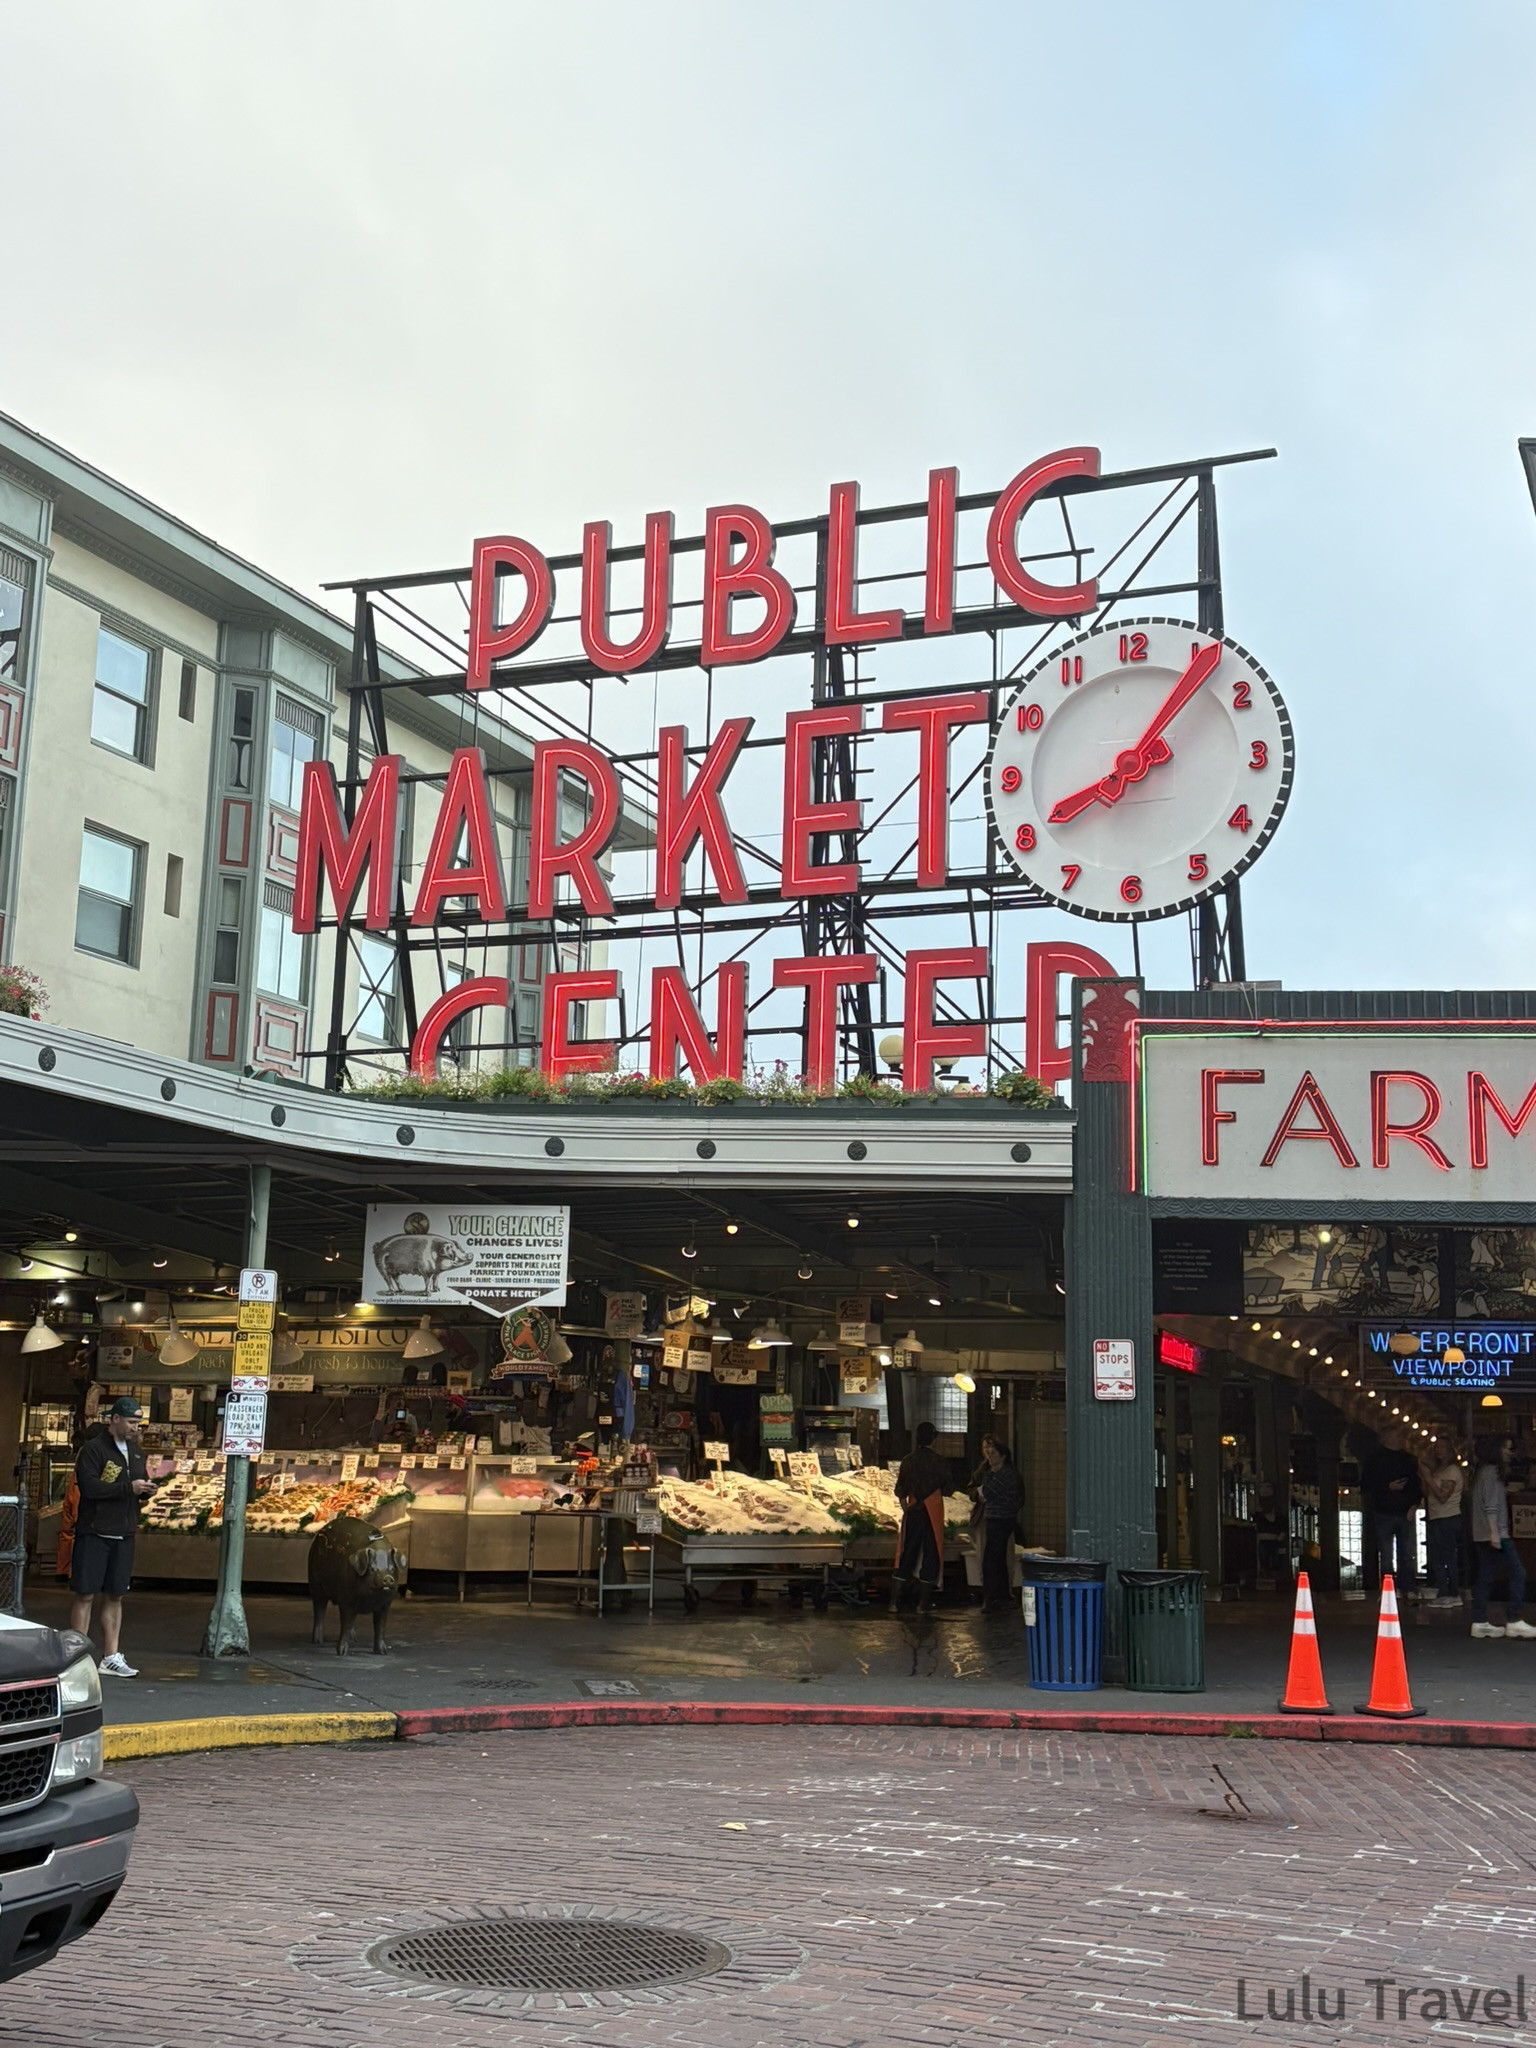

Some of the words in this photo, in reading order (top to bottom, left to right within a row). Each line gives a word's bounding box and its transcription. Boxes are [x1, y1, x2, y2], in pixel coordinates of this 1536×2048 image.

[466, 447, 1101, 691] PUBLIC
[1119, 632, 1148, 663] 12
[1061, 656, 1083, 686] 11
[1232, 681, 1252, 709] 2
[1017, 704, 1043, 733] 10
[1248, 740, 1268, 770] 3
[1001, 766, 1022, 792] 9
[292, 693, 989, 935] MARKET
[1227, 804, 1252, 832] 4
[1016, 824, 1037, 852] 8
[1060, 864, 1082, 891] 7
[1188, 854, 1208, 881] 5
[1121, 876, 1143, 903] 6
[1201, 1069, 1536, 1171] FARM
[448, 1215, 494, 1236] YOUR
[495, 1215, 564, 1237] CHANGE
[466, 1238, 522, 1247] CHANGES
[525, 1239, 563, 1247] LIVES!
[524, 1261, 539, 1269] PIKE
[465, 1289, 508, 1298] DONATE
[510, 1290, 540, 1298] HERE!
[507, 1343, 524, 1358] PLACE
[1096, 1342, 1108, 1351] NO
[1370, 1331, 1534, 1354] WERFRONT
[524, 1364, 554, 1372] FAMOUS
[1100, 1354, 1129, 1364] STOPS
[1392, 1359, 1514, 1376] VIEWPOINT
[1410, 1377, 1417, 1385] &
[1420, 1378, 1452, 1386] PUBLIC
[1454, 1377, 1496, 1387] SEATING
[229, 1405, 263, 1413] PASSENGER
[232, 1394, 238, 1402] 3
[228, 1413, 244, 1421] LOAD
[247, 1413, 263, 1421] ONLY
